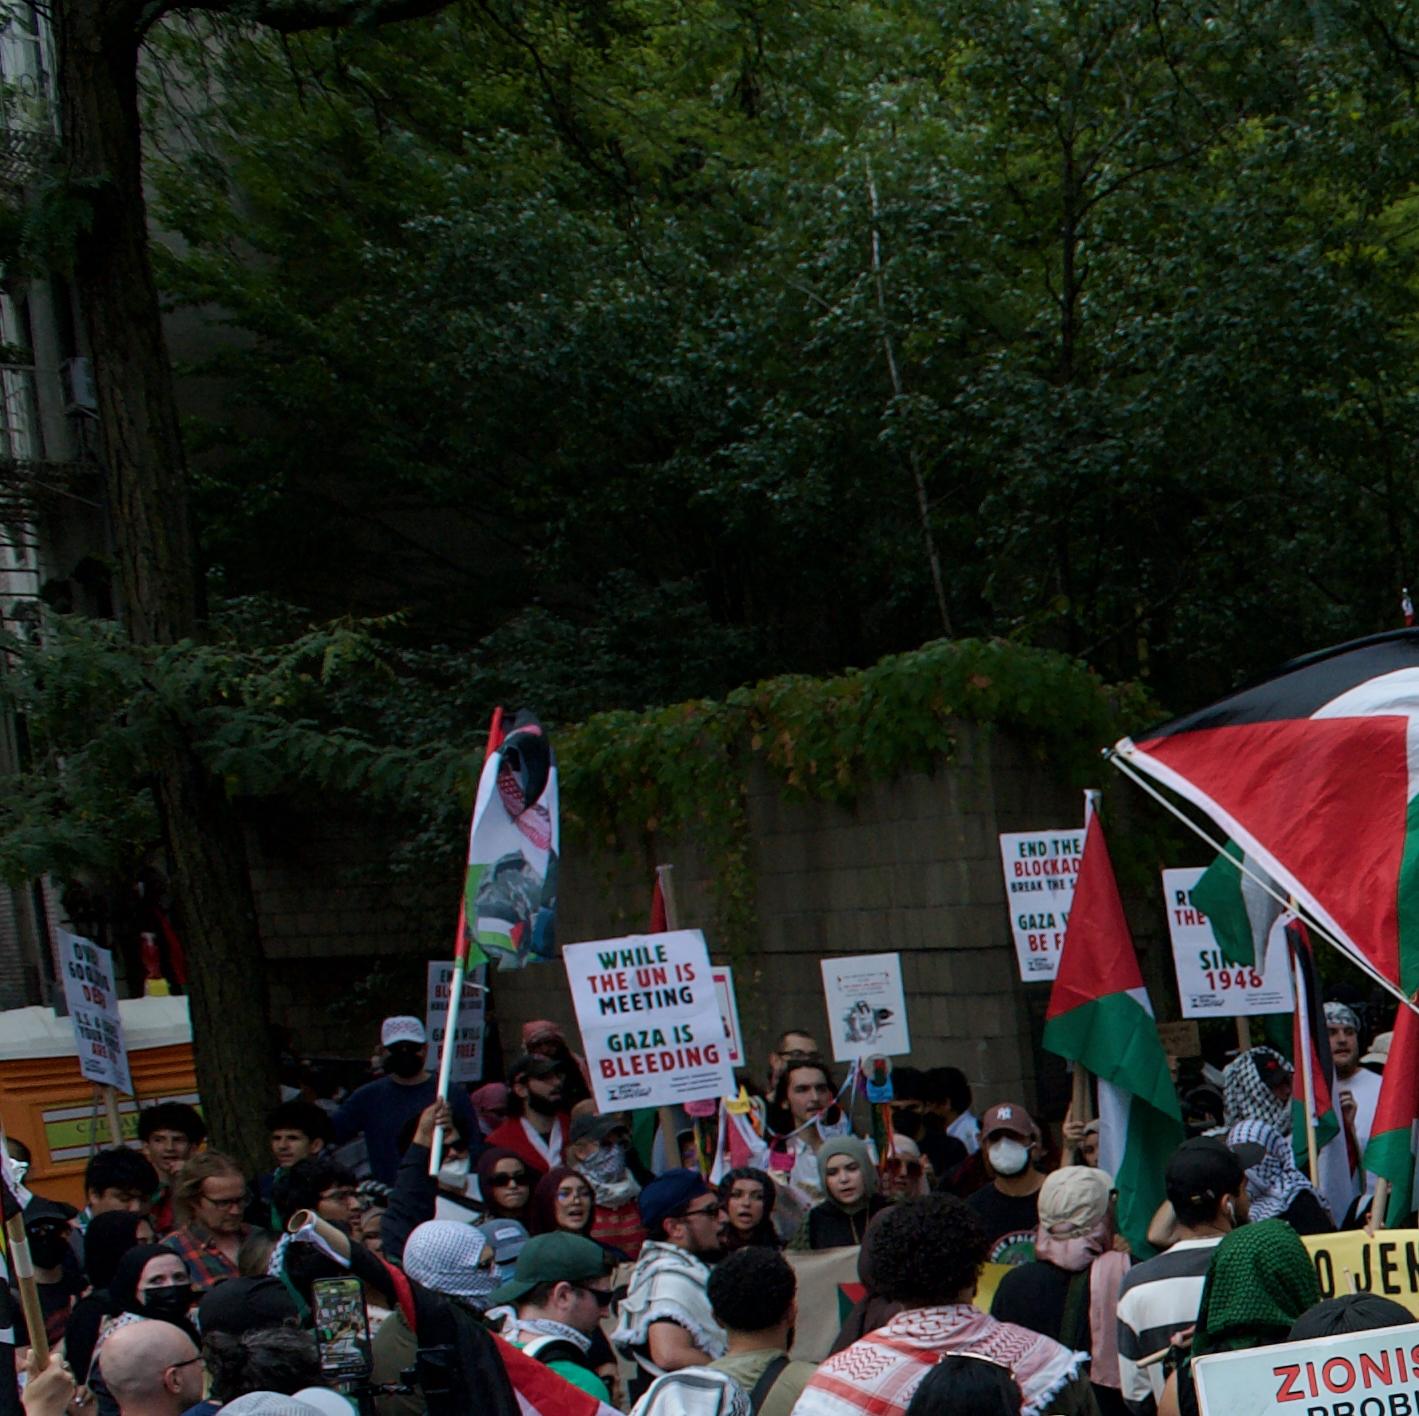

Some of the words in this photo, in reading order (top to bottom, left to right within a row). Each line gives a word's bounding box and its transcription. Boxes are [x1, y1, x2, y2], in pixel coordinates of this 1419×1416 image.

[1019, 841, 1047, 858] END
[1052, 838, 1081, 855] THE
[1014, 858, 1082, 877] BLOCKAD
[1011, 881, 1042, 893] BREAK
[1047, 879, 1065, 891] THE
[1018, 913, 1056, 930] GAZA
[1174, 909, 1207, 926] THE
[1028, 934, 1048, 951] BE
[597, 944, 667, 970] WHILE
[587, 972, 628, 994] THE
[636, 967, 667, 988] UN
[675, 962, 696, 982] IS
[1206, 969, 1263, 991] 1948
[599, 986, 693, 1015] MEETING
[607, 1029, 666, 1052] GAZA
[673, 1024, 694, 1044] IS
[599, 1044, 719, 1079] BLEEDING
